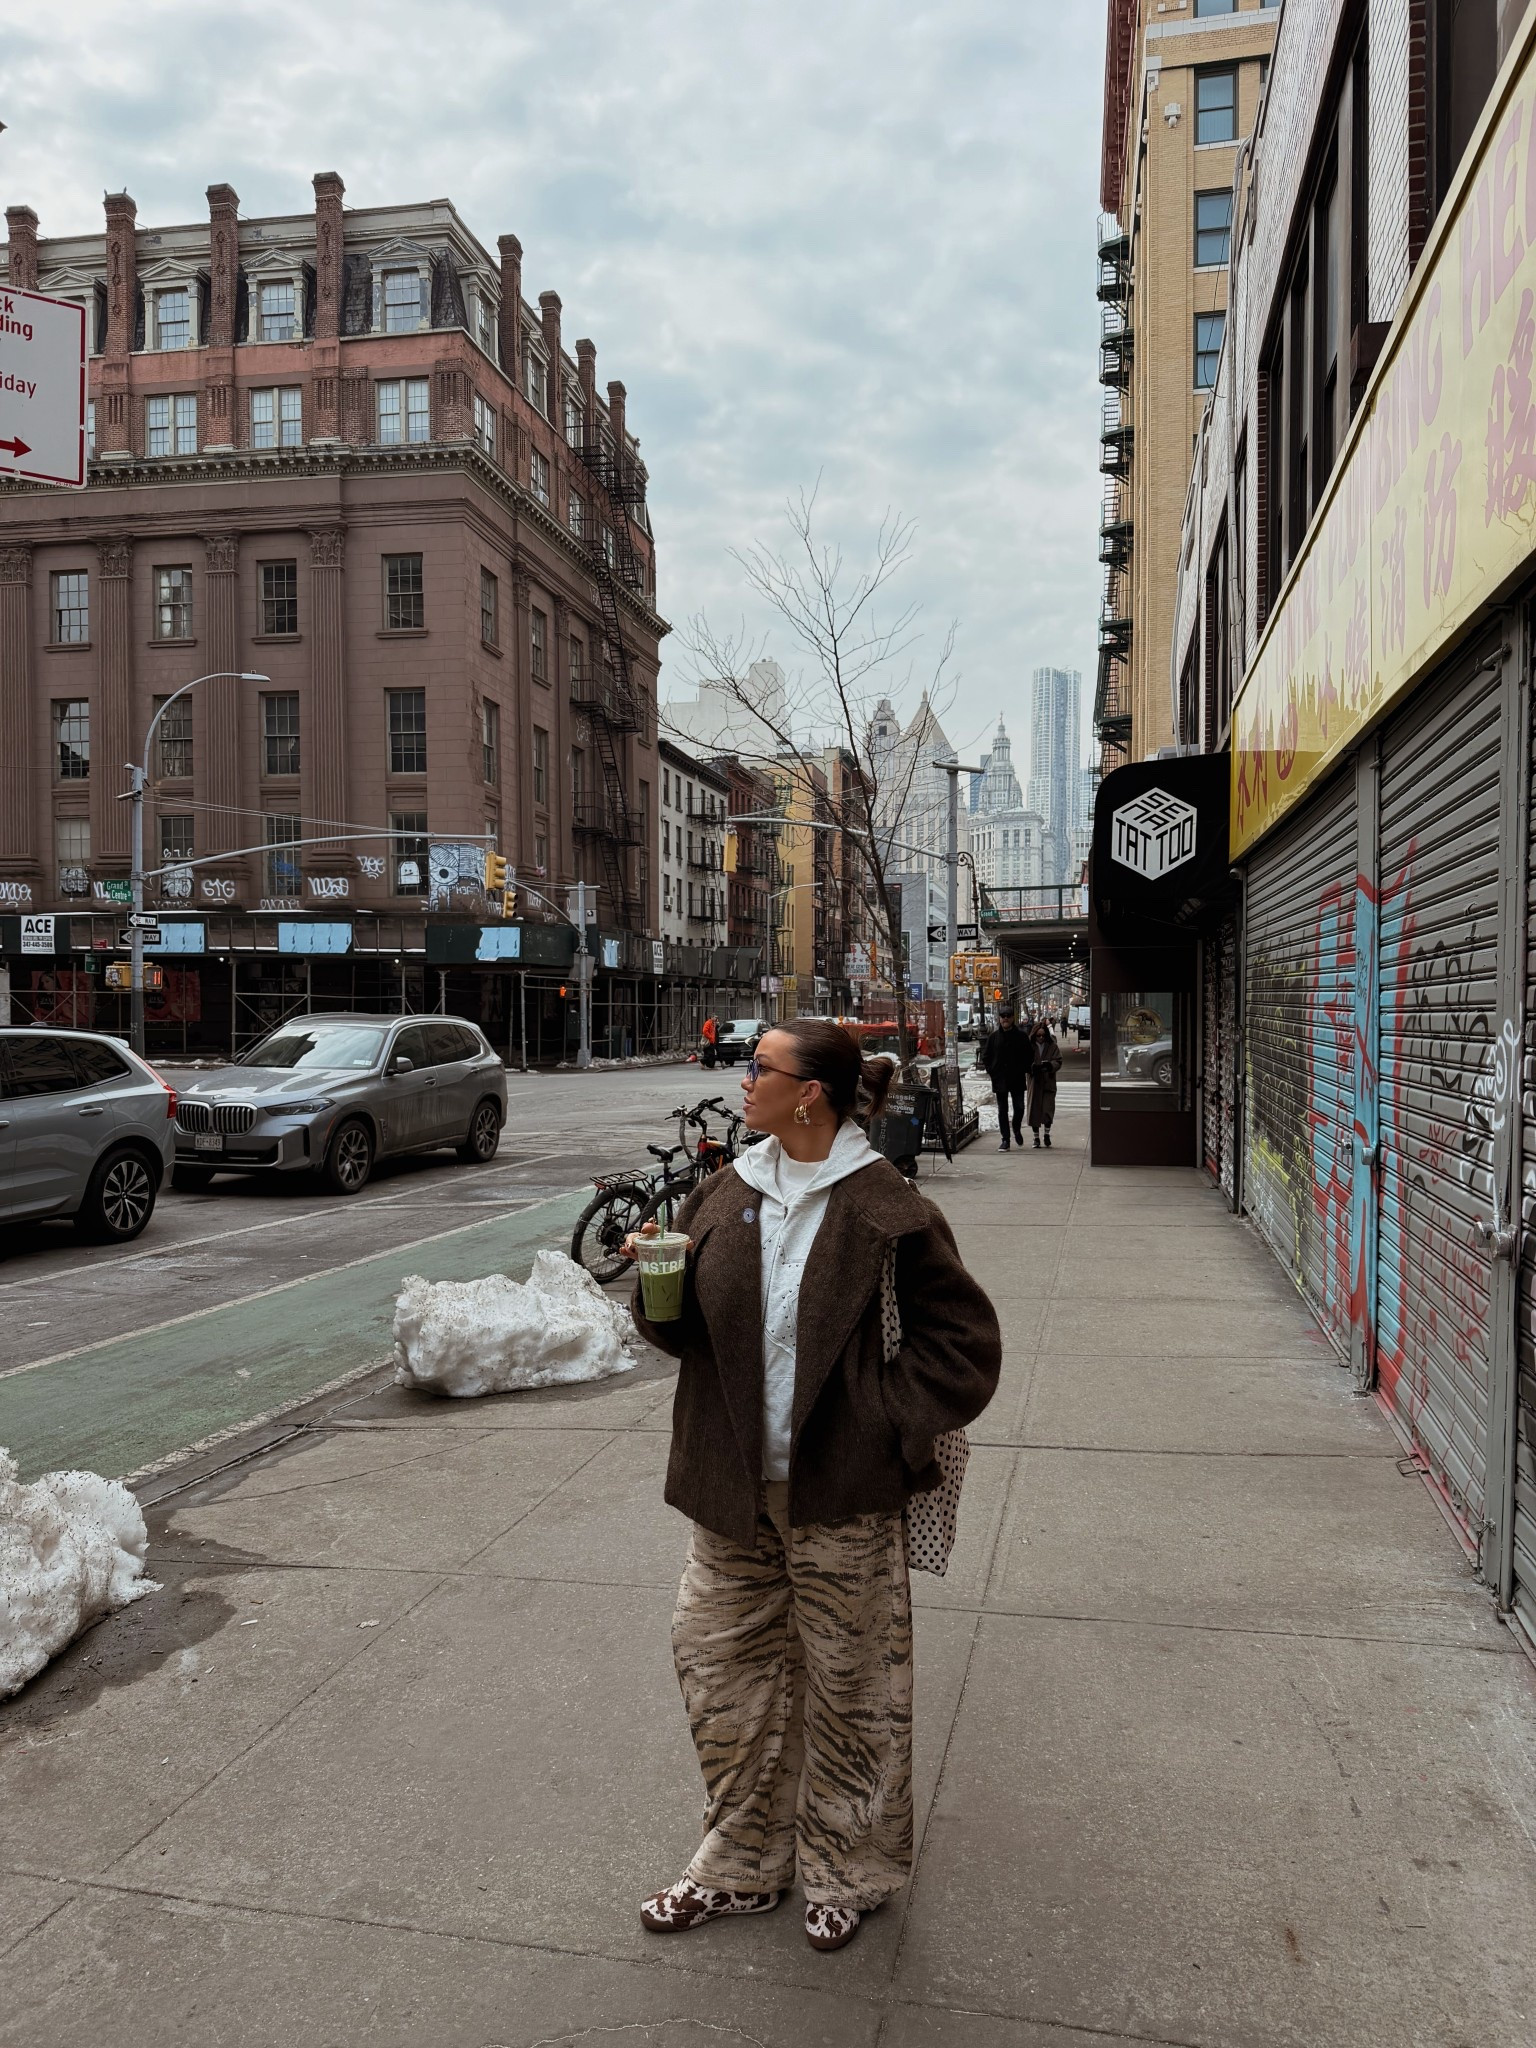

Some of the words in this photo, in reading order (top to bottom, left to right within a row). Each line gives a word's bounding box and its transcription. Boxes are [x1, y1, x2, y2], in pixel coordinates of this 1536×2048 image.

[1327, 281, 1443, 585] PLUMBING
[1463, 98, 1536, 353] HE
[106, 881, 124, 890] Grand
[111, 890, 128, 900] Centre
[24, 919, 51, 933] ACE
[145, 917, 154, 925] WAY
[936, 930, 946, 938] ON
[957, 928, 973, 937] WAY
[654, 944, 663, 957] ACE
[153, 971, 161, 985] 11
